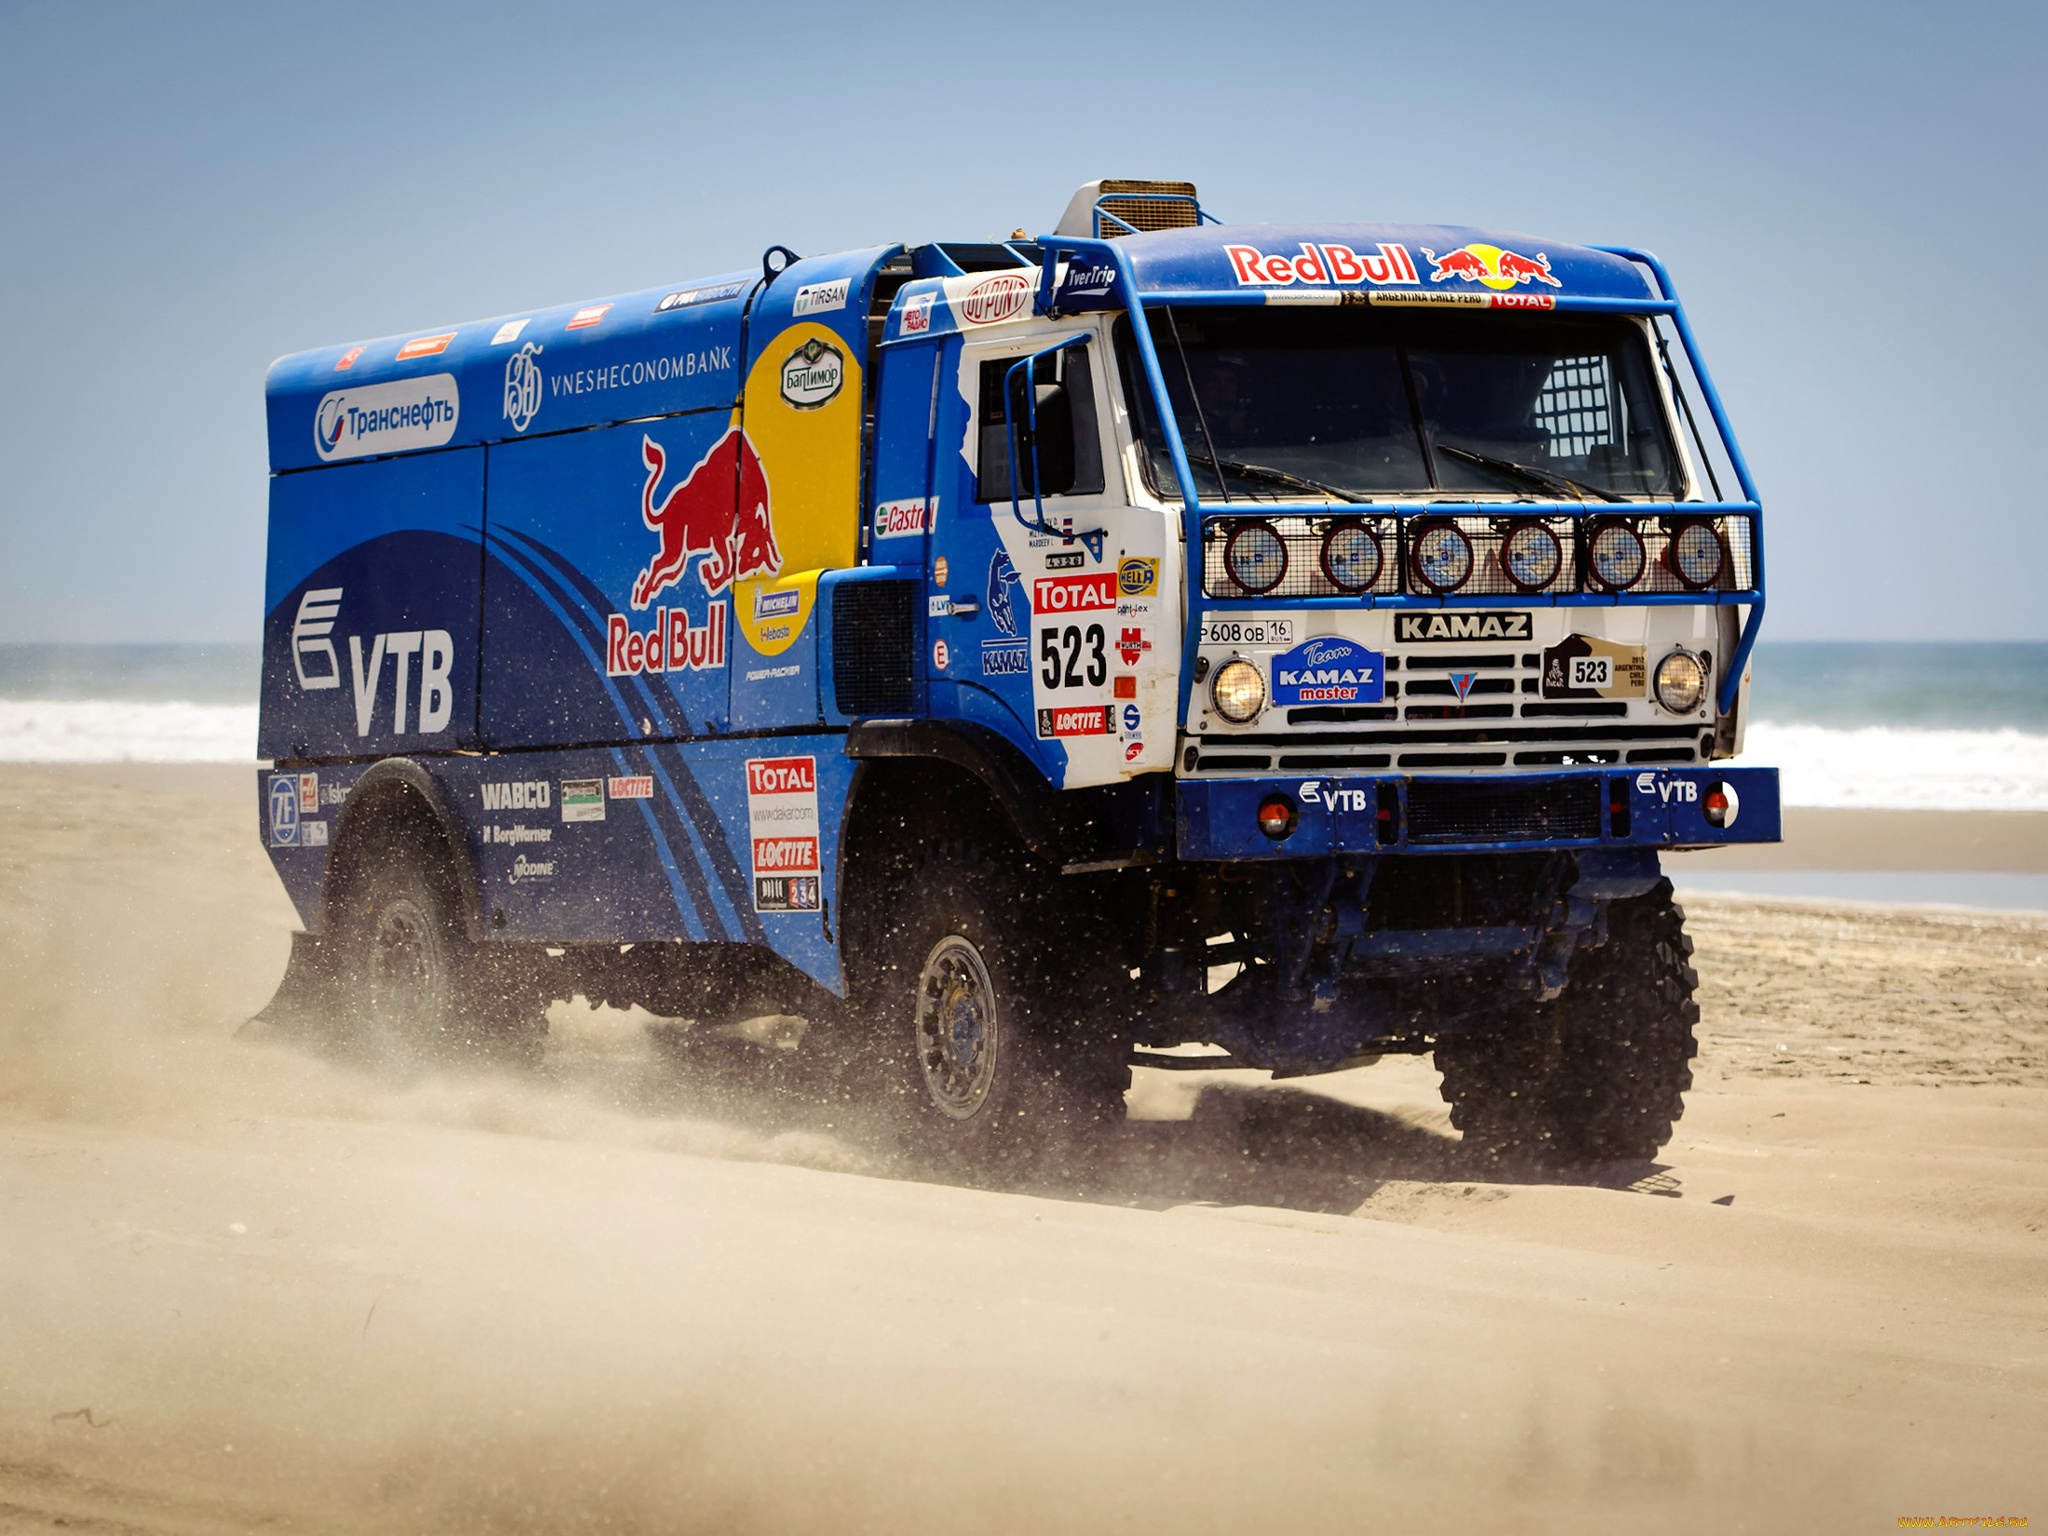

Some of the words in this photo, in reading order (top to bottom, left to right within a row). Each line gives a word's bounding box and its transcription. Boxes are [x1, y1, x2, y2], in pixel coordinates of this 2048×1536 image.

[1223, 243, 1331, 285] Red
[1318, 243, 1421, 285] Bull
[1069, 265, 1116, 287] TverTrip
[1376, 292, 1427, 302] ARGENTINA
[1429, 294, 1455, 303] CHILE
[1457, 295, 1482, 304] PERU
[1493, 293, 1550, 307] TOTAL
[551, 346, 731, 397] VNESHECONOMBANK
[347, 397, 454, 440] Транснефть
[1048, 557, 1080, 567] 4326
[1121, 569, 1155, 585] HELLA
[762, 595, 798, 612] MICHELIN
[1036, 579, 1116, 610] TOTAL
[1271, 622, 1286, 636] 16
[1402, 615, 1528, 639] KAMAZ
[607, 606, 667, 677] Red
[667, 600, 727, 672] Bull
[982, 649, 1028, 675] KAMAZ
[1041, 623, 1107, 690] 523
[1303, 642, 1352, 667] Team
[1279, 669, 1374, 685] KAMAZ
[1575, 661, 1607, 683] 523
[1614, 664, 1645, 672] ARGENTINA
[1629, 671, 1645, 679] CHILE
[349, 629, 454, 738] VTB
[1300, 686, 1357, 700] master
[1630, 679, 1644, 687] PERU
[1056, 712, 1102, 730] LOCTITE
[611, 779, 652, 797] LOCTITE
[750, 764, 813, 790] TOTAL
[481, 781, 551, 810] WABCO
[1323, 790, 1366, 812] VTB
[1658, 781, 1698, 803] VTB
[753, 806, 814, 821] www.dakar.com
[493, 825, 552, 846] BorgWarner
[757, 841, 813, 868] LOCTITE
[514, 862, 554, 876] MODINE
